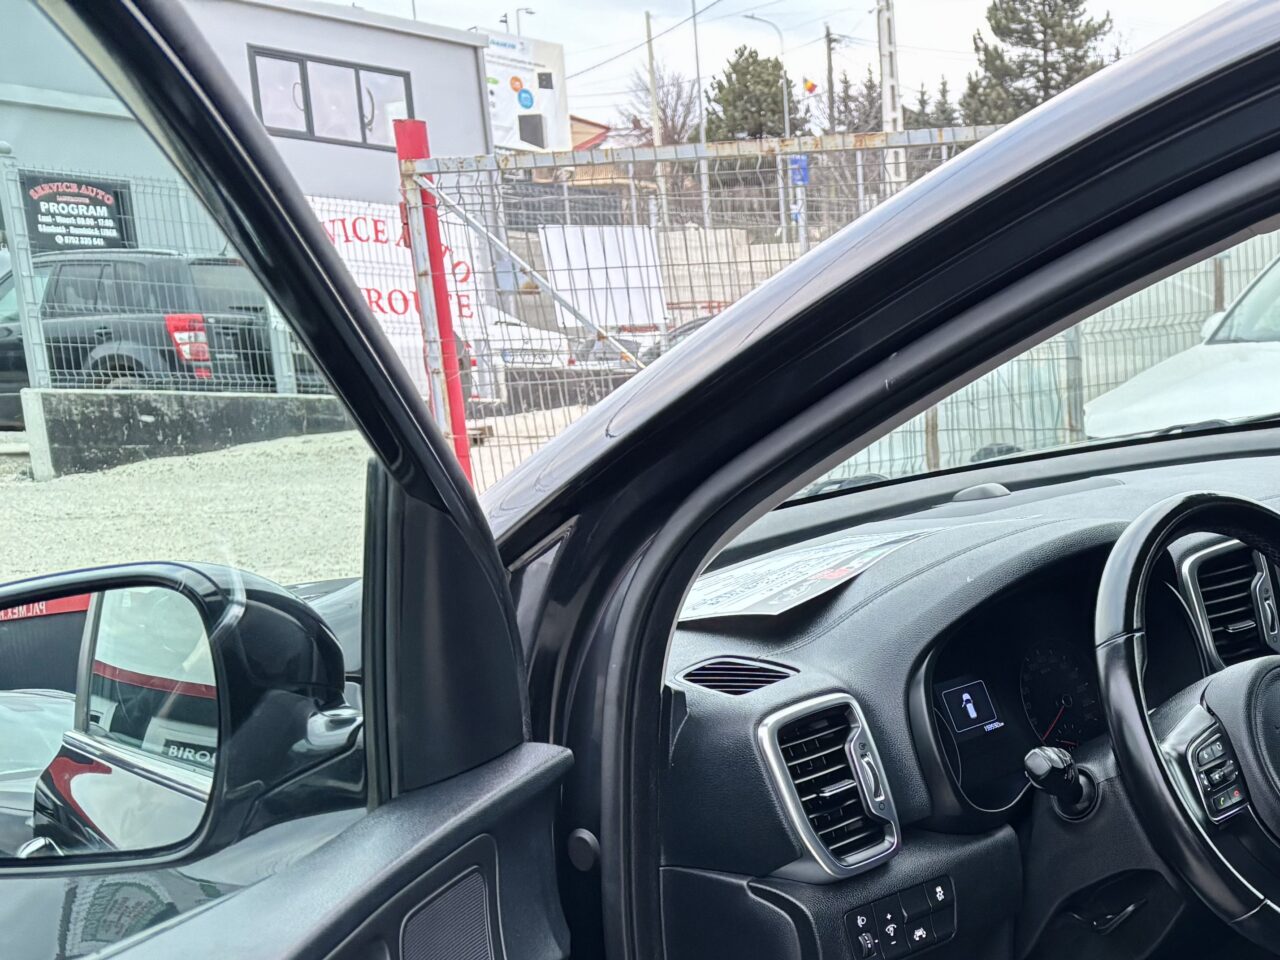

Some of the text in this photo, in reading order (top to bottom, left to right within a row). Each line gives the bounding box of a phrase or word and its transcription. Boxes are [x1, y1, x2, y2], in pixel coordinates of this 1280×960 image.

[29, 182, 78, 199] SERVICE
[79, 185, 114, 205] AUTO
[39, 201, 108, 217] PROGRAM
